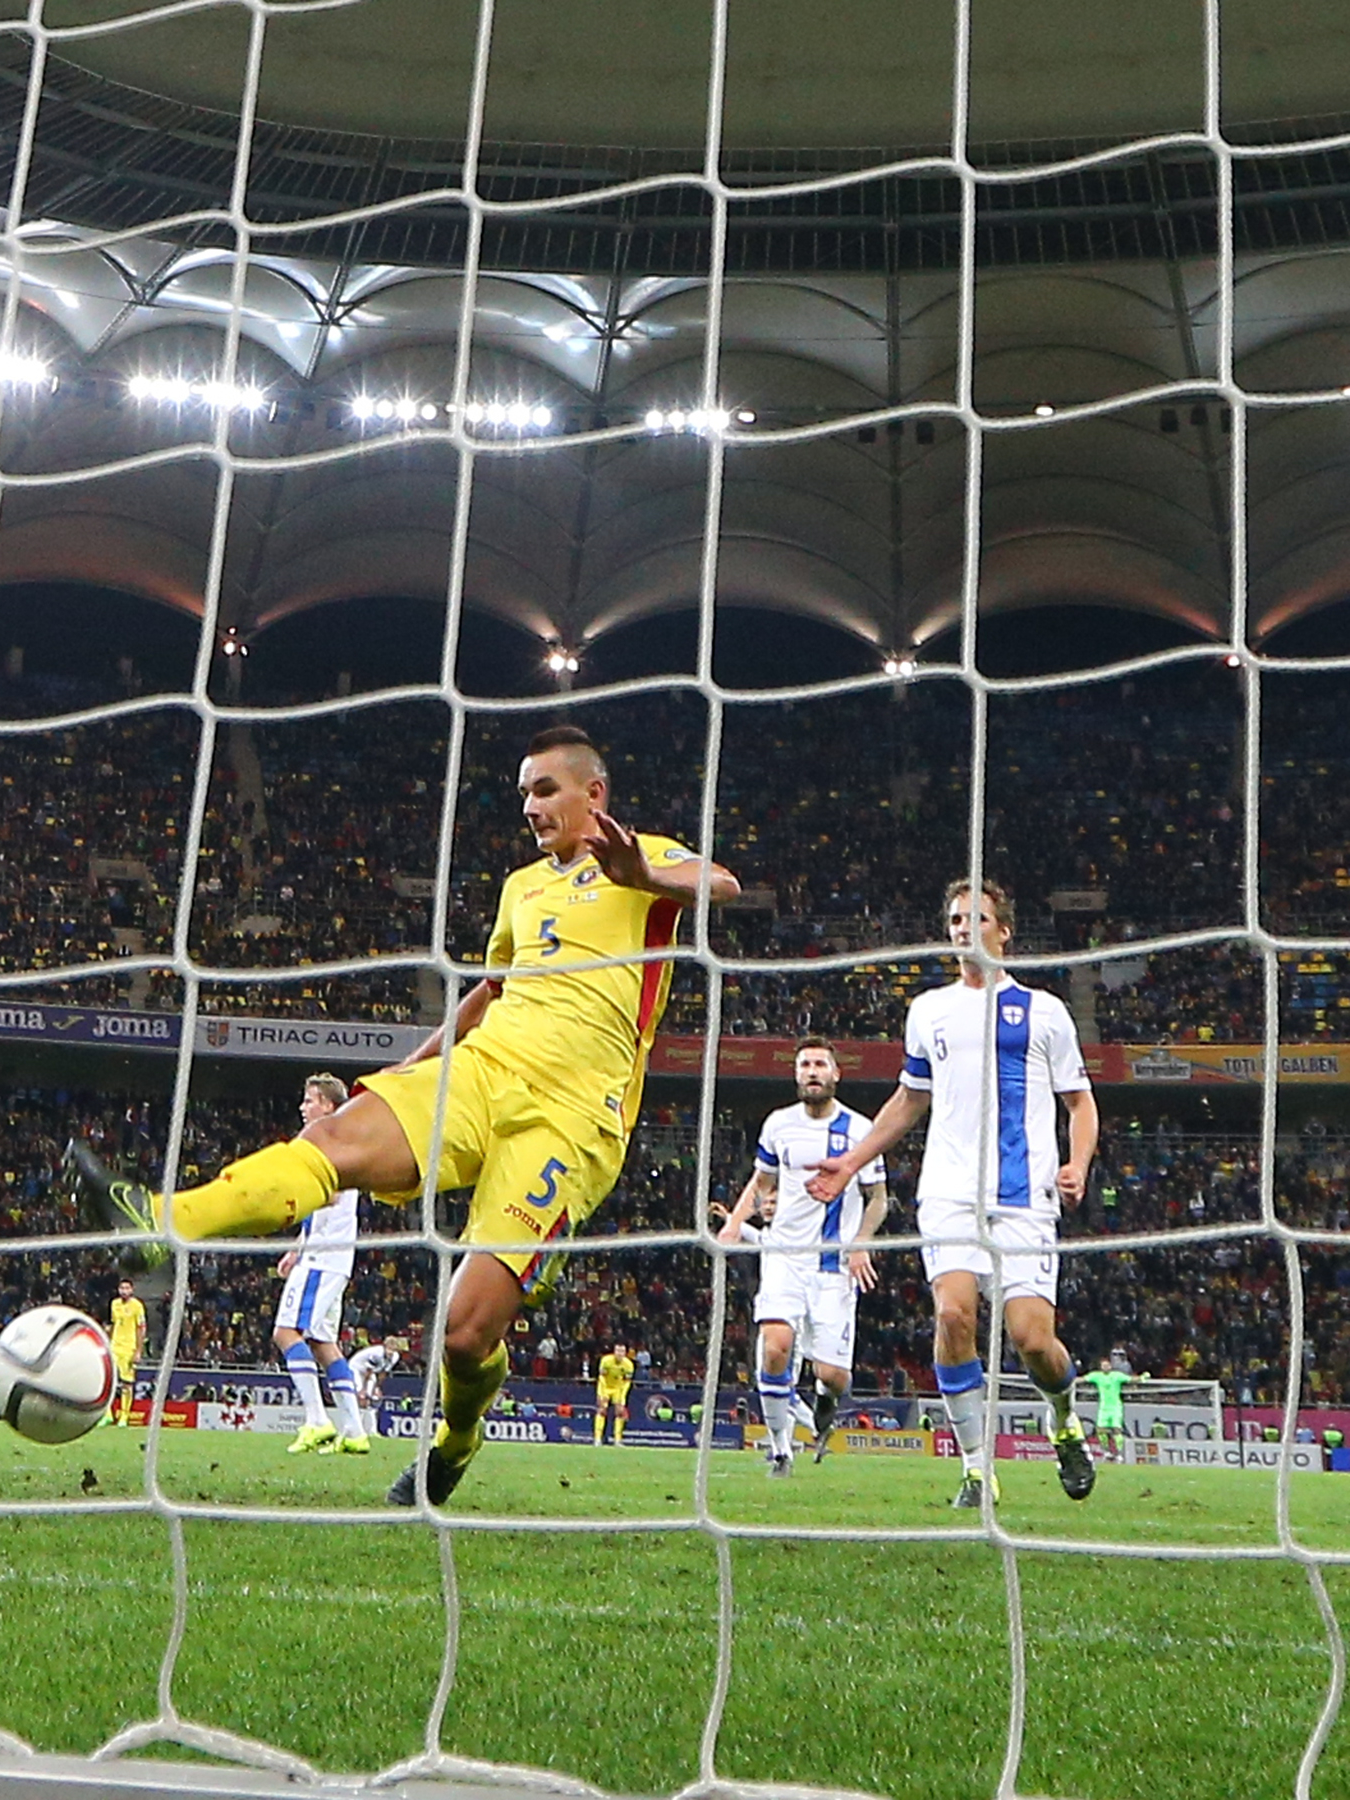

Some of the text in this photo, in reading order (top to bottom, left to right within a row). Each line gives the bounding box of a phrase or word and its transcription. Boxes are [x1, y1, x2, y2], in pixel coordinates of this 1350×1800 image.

[539, 917, 561, 957] 5
[237, 1026, 394, 1048] TIRIAC AUTO
[933, 1027, 948, 1061] 5
[1281, 1057, 1339, 1073] GALBEN
[525, 1156, 568, 1208] 5
